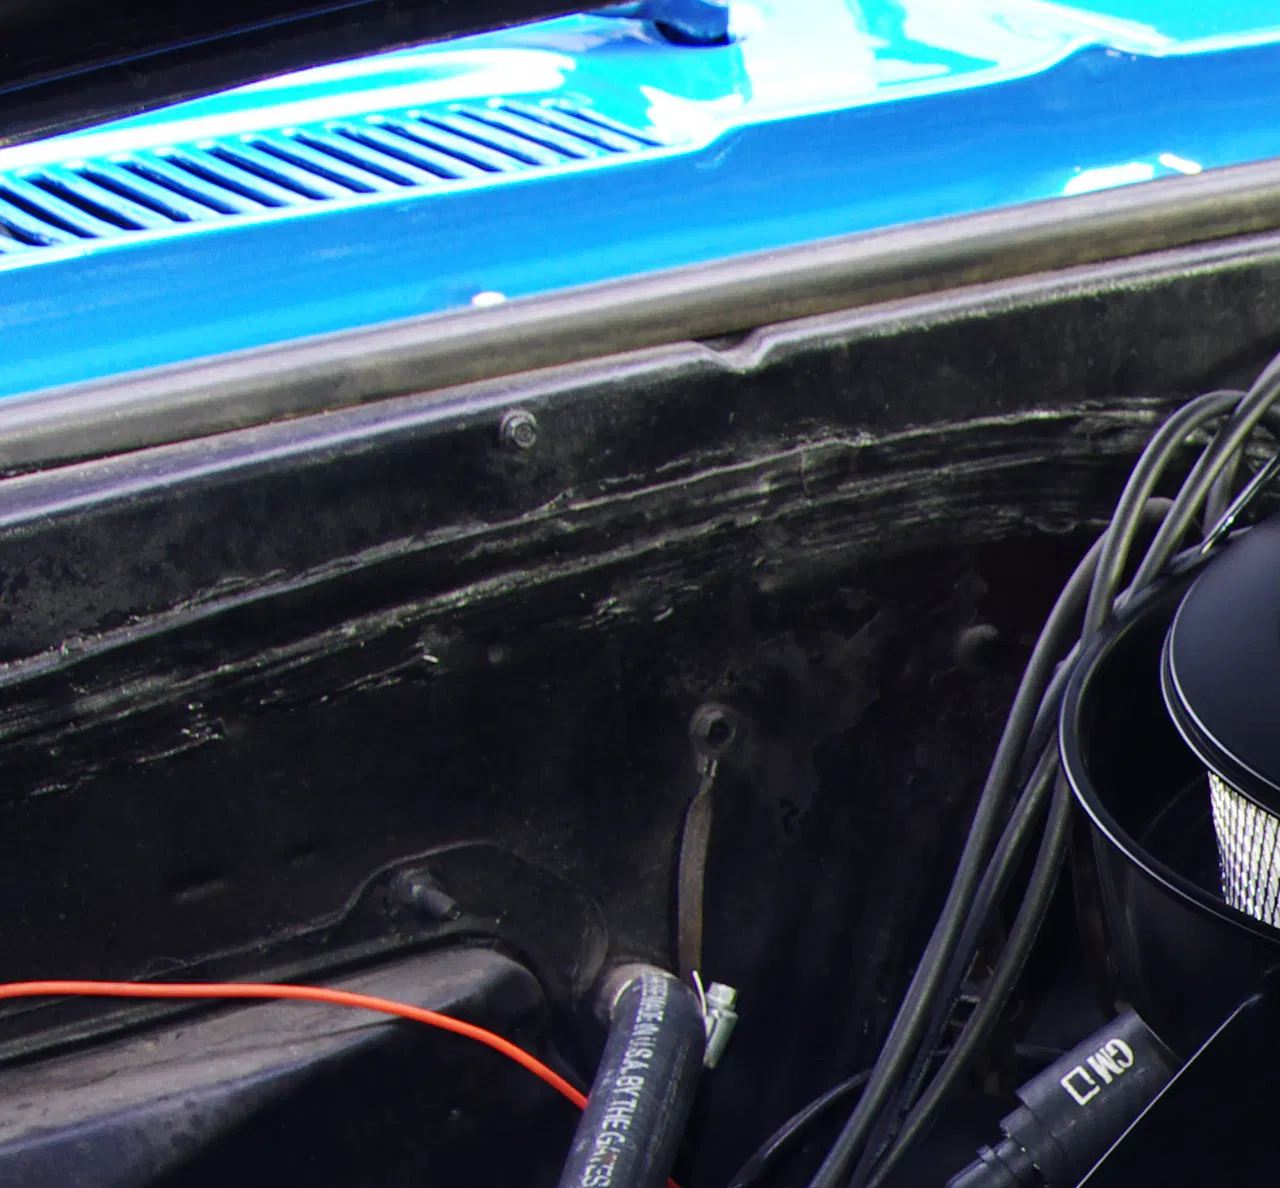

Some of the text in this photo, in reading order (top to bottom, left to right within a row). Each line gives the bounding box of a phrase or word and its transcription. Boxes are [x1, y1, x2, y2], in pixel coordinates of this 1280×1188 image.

[1086, 1037, 1135, 1085] GM
[613, 1075, 645, 1100] BY
[602, 1099, 639, 1131] THE
[580, 1131, 626, 1188] GATES
